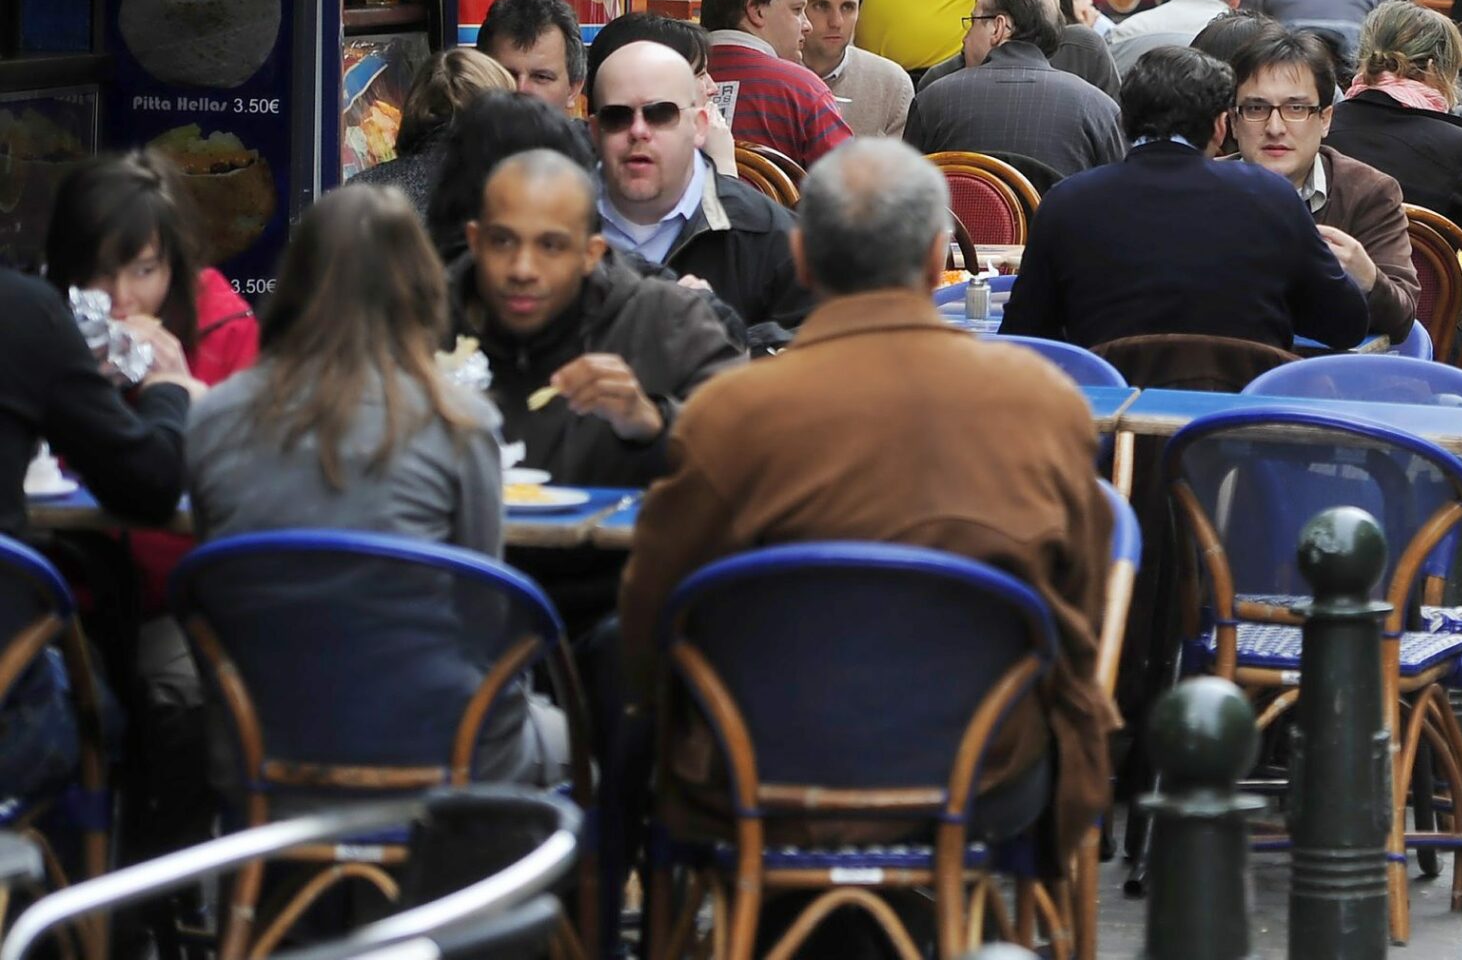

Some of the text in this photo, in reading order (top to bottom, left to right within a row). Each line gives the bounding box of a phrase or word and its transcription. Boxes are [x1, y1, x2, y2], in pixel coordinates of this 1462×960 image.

[132, 96, 280, 114] Pitta Hellas 3.50€
[231, 278, 277, 294] 3.50€
